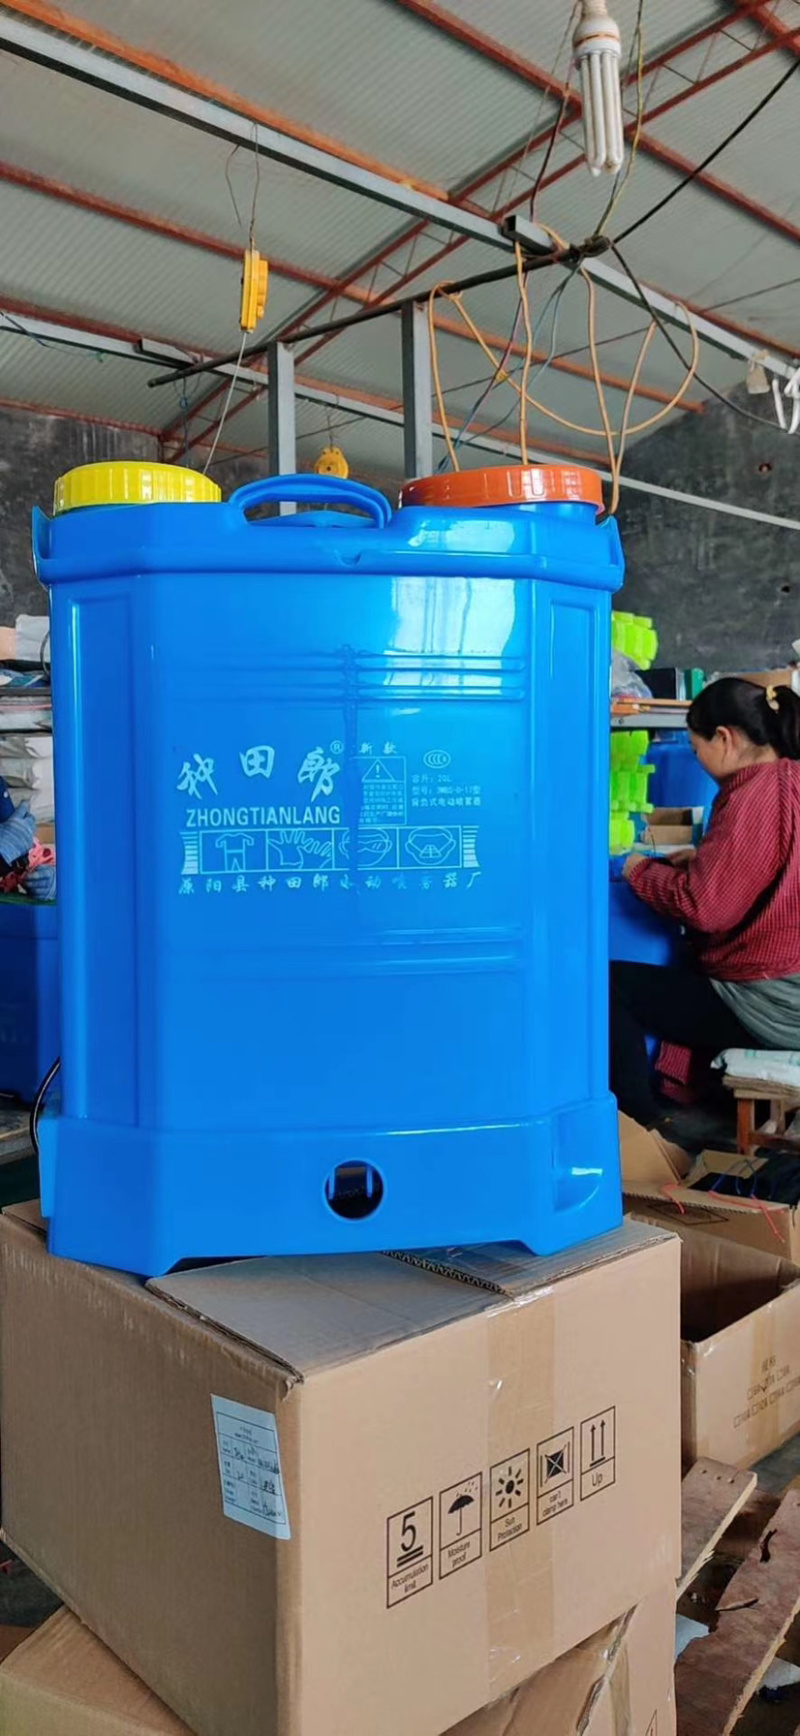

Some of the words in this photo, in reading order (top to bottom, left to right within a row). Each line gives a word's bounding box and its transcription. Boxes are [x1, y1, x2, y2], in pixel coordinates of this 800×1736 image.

[176, 745, 341, 802] 种田郎
[186, 805, 341, 827] ZHONGTIANLANG
[591, 1472, 603, 1487] Up
[504, 1516, 516, 1528] Sun
[401, 1511, 416, 1553] 5
[497, 1523, 523, 1542] Protection
[447, 1541, 471, 1559] Moisture
[451, 1554, 467, 1569] proof
[391, 1563, 430, 1590] Accumulation
[403, 1581, 418, 1594] limit
